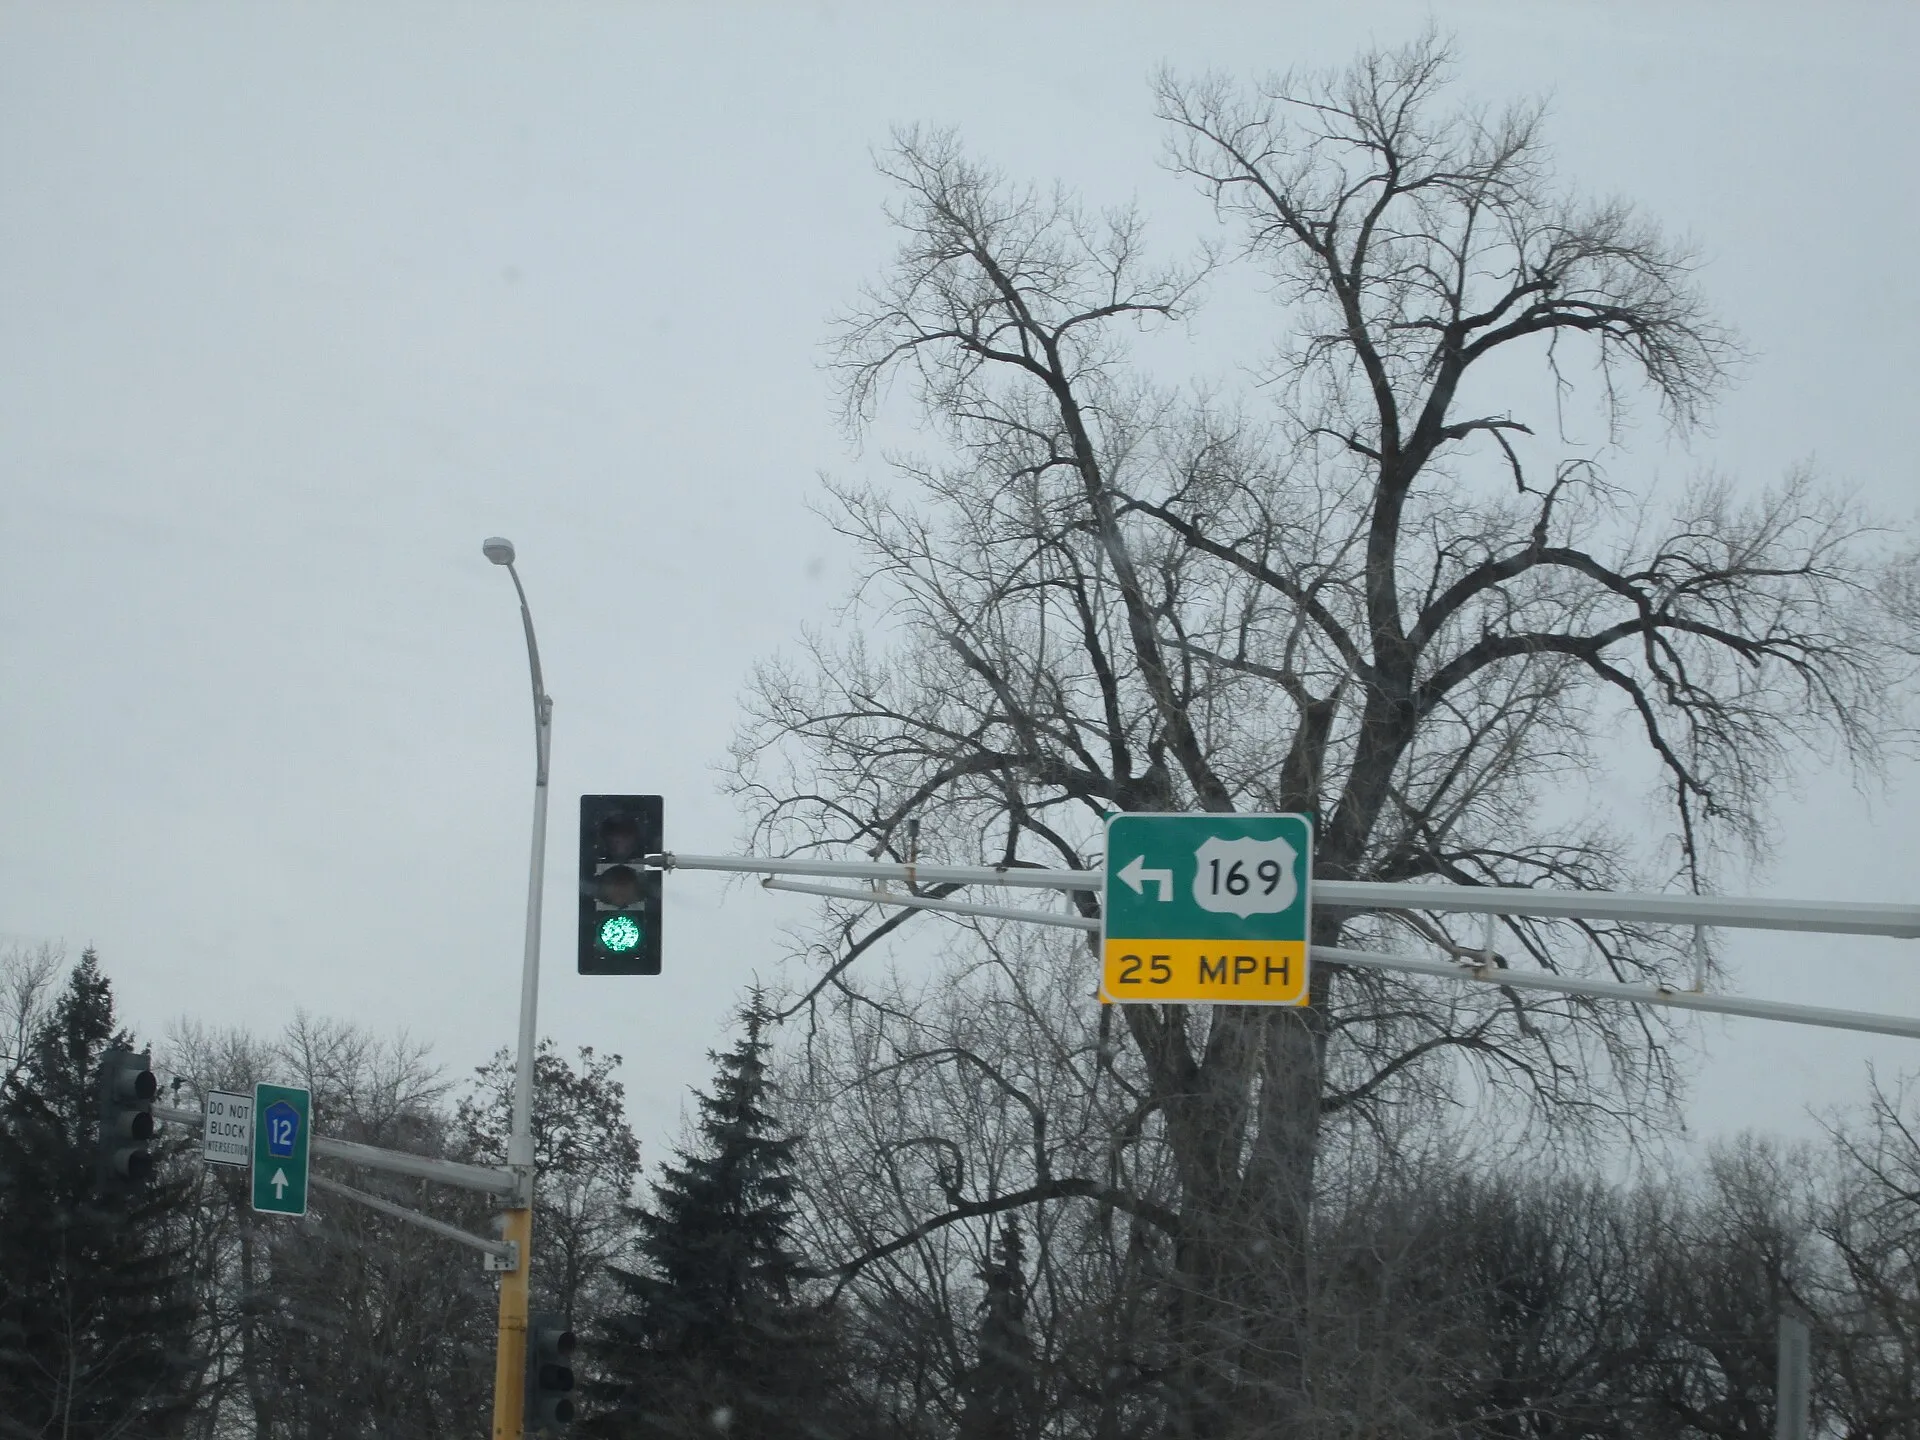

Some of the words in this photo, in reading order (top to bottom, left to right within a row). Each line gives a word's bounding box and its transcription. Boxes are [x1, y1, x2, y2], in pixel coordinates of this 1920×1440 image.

[1209, 858, 1281, 896] 169
[1119, 955, 1172, 984] 25
[1199, 956, 1289, 985] MPH
[210, 1101, 224, 1115] DO
[230, 1105, 249, 1119] NOT
[211, 1121, 245, 1138] BLOCK
[273, 1118, 291, 1146] 12
